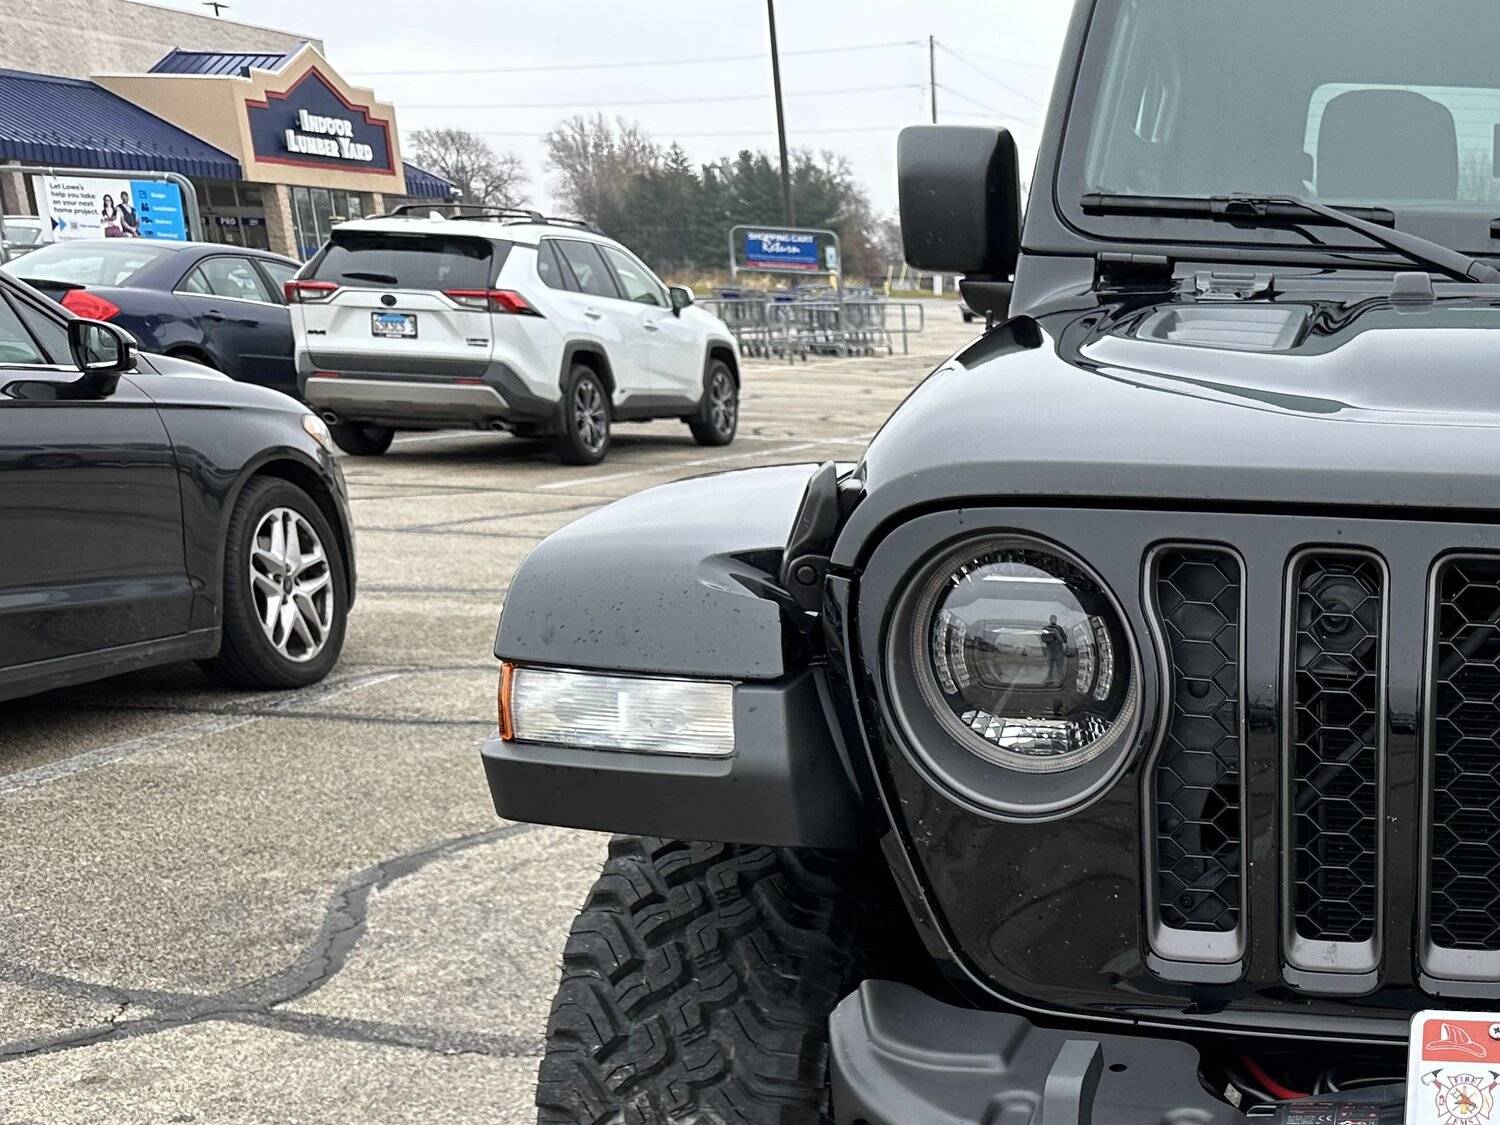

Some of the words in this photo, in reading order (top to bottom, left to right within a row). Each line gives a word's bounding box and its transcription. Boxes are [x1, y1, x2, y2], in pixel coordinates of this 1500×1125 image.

[298, 109, 354, 138] INDOOR
[284, 129, 341, 158] LUMBER
[336, 137, 374, 162] YARD
[62, 183, 84, 191] Lowe's
